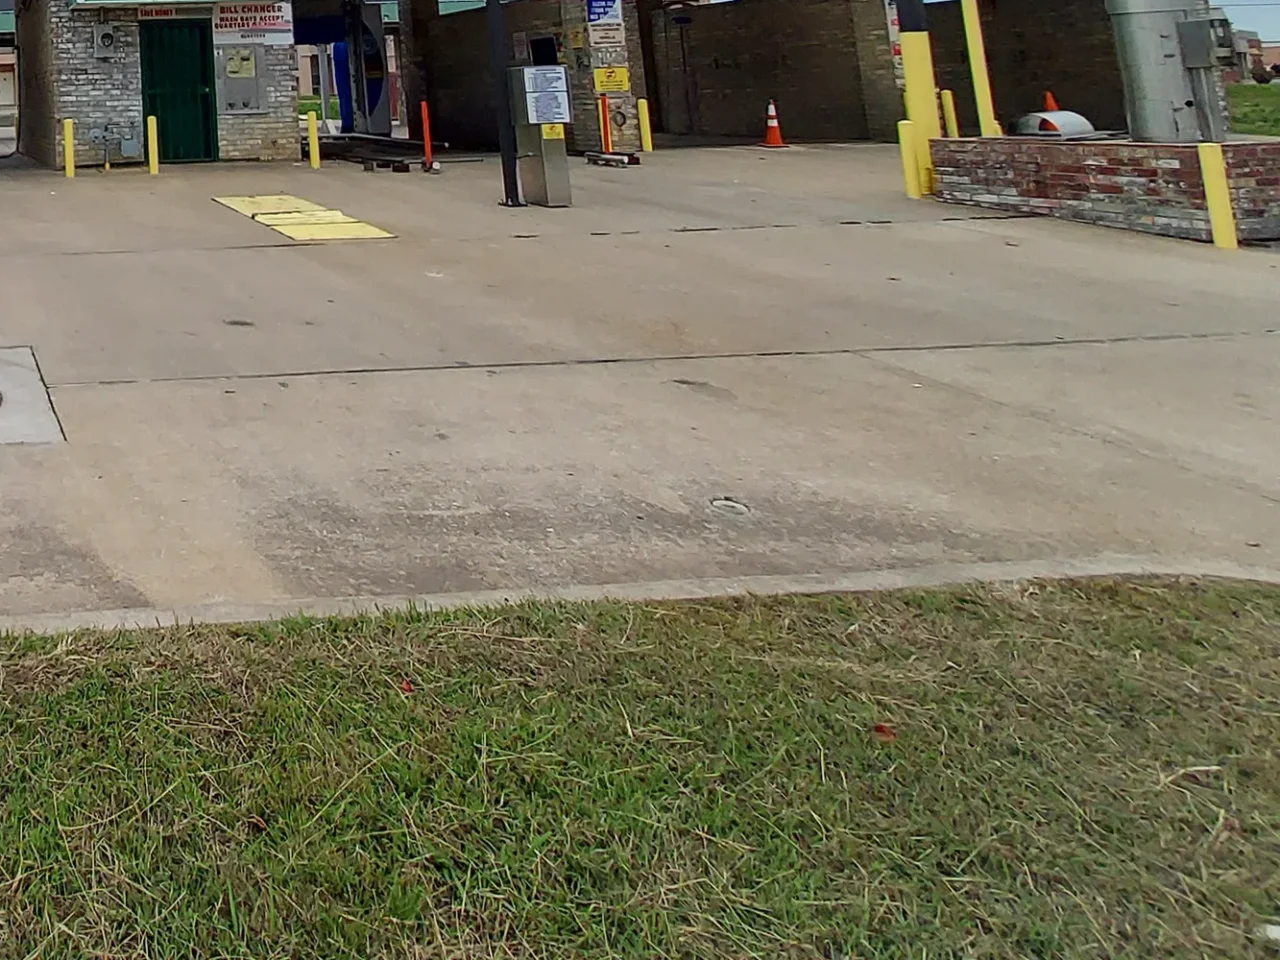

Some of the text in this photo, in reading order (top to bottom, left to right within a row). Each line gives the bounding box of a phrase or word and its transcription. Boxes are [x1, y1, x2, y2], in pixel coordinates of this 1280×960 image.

[220, 4, 283, 15] BILL CHANGER
[214, 21, 250, 29] QUARTERS
